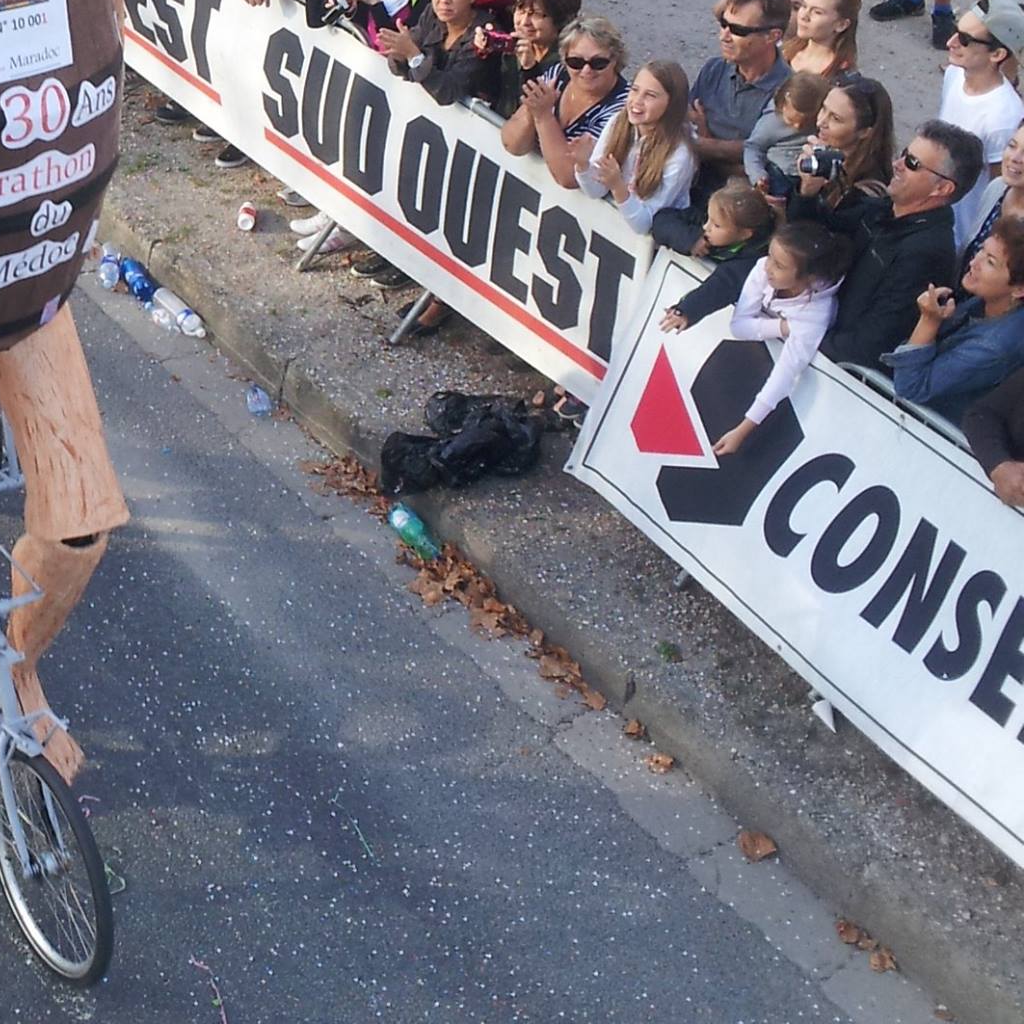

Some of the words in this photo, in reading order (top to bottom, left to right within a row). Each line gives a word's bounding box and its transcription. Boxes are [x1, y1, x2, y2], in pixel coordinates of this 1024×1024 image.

[4, 84, 67, 143] 30
[76, 82, 113, 122] Ans
[263, 27, 391, 196] SUD
[397, 115, 637, 364] OUEST
[34, 204, 68, 233] du
[762, 452, 1024, 746] CONSE
